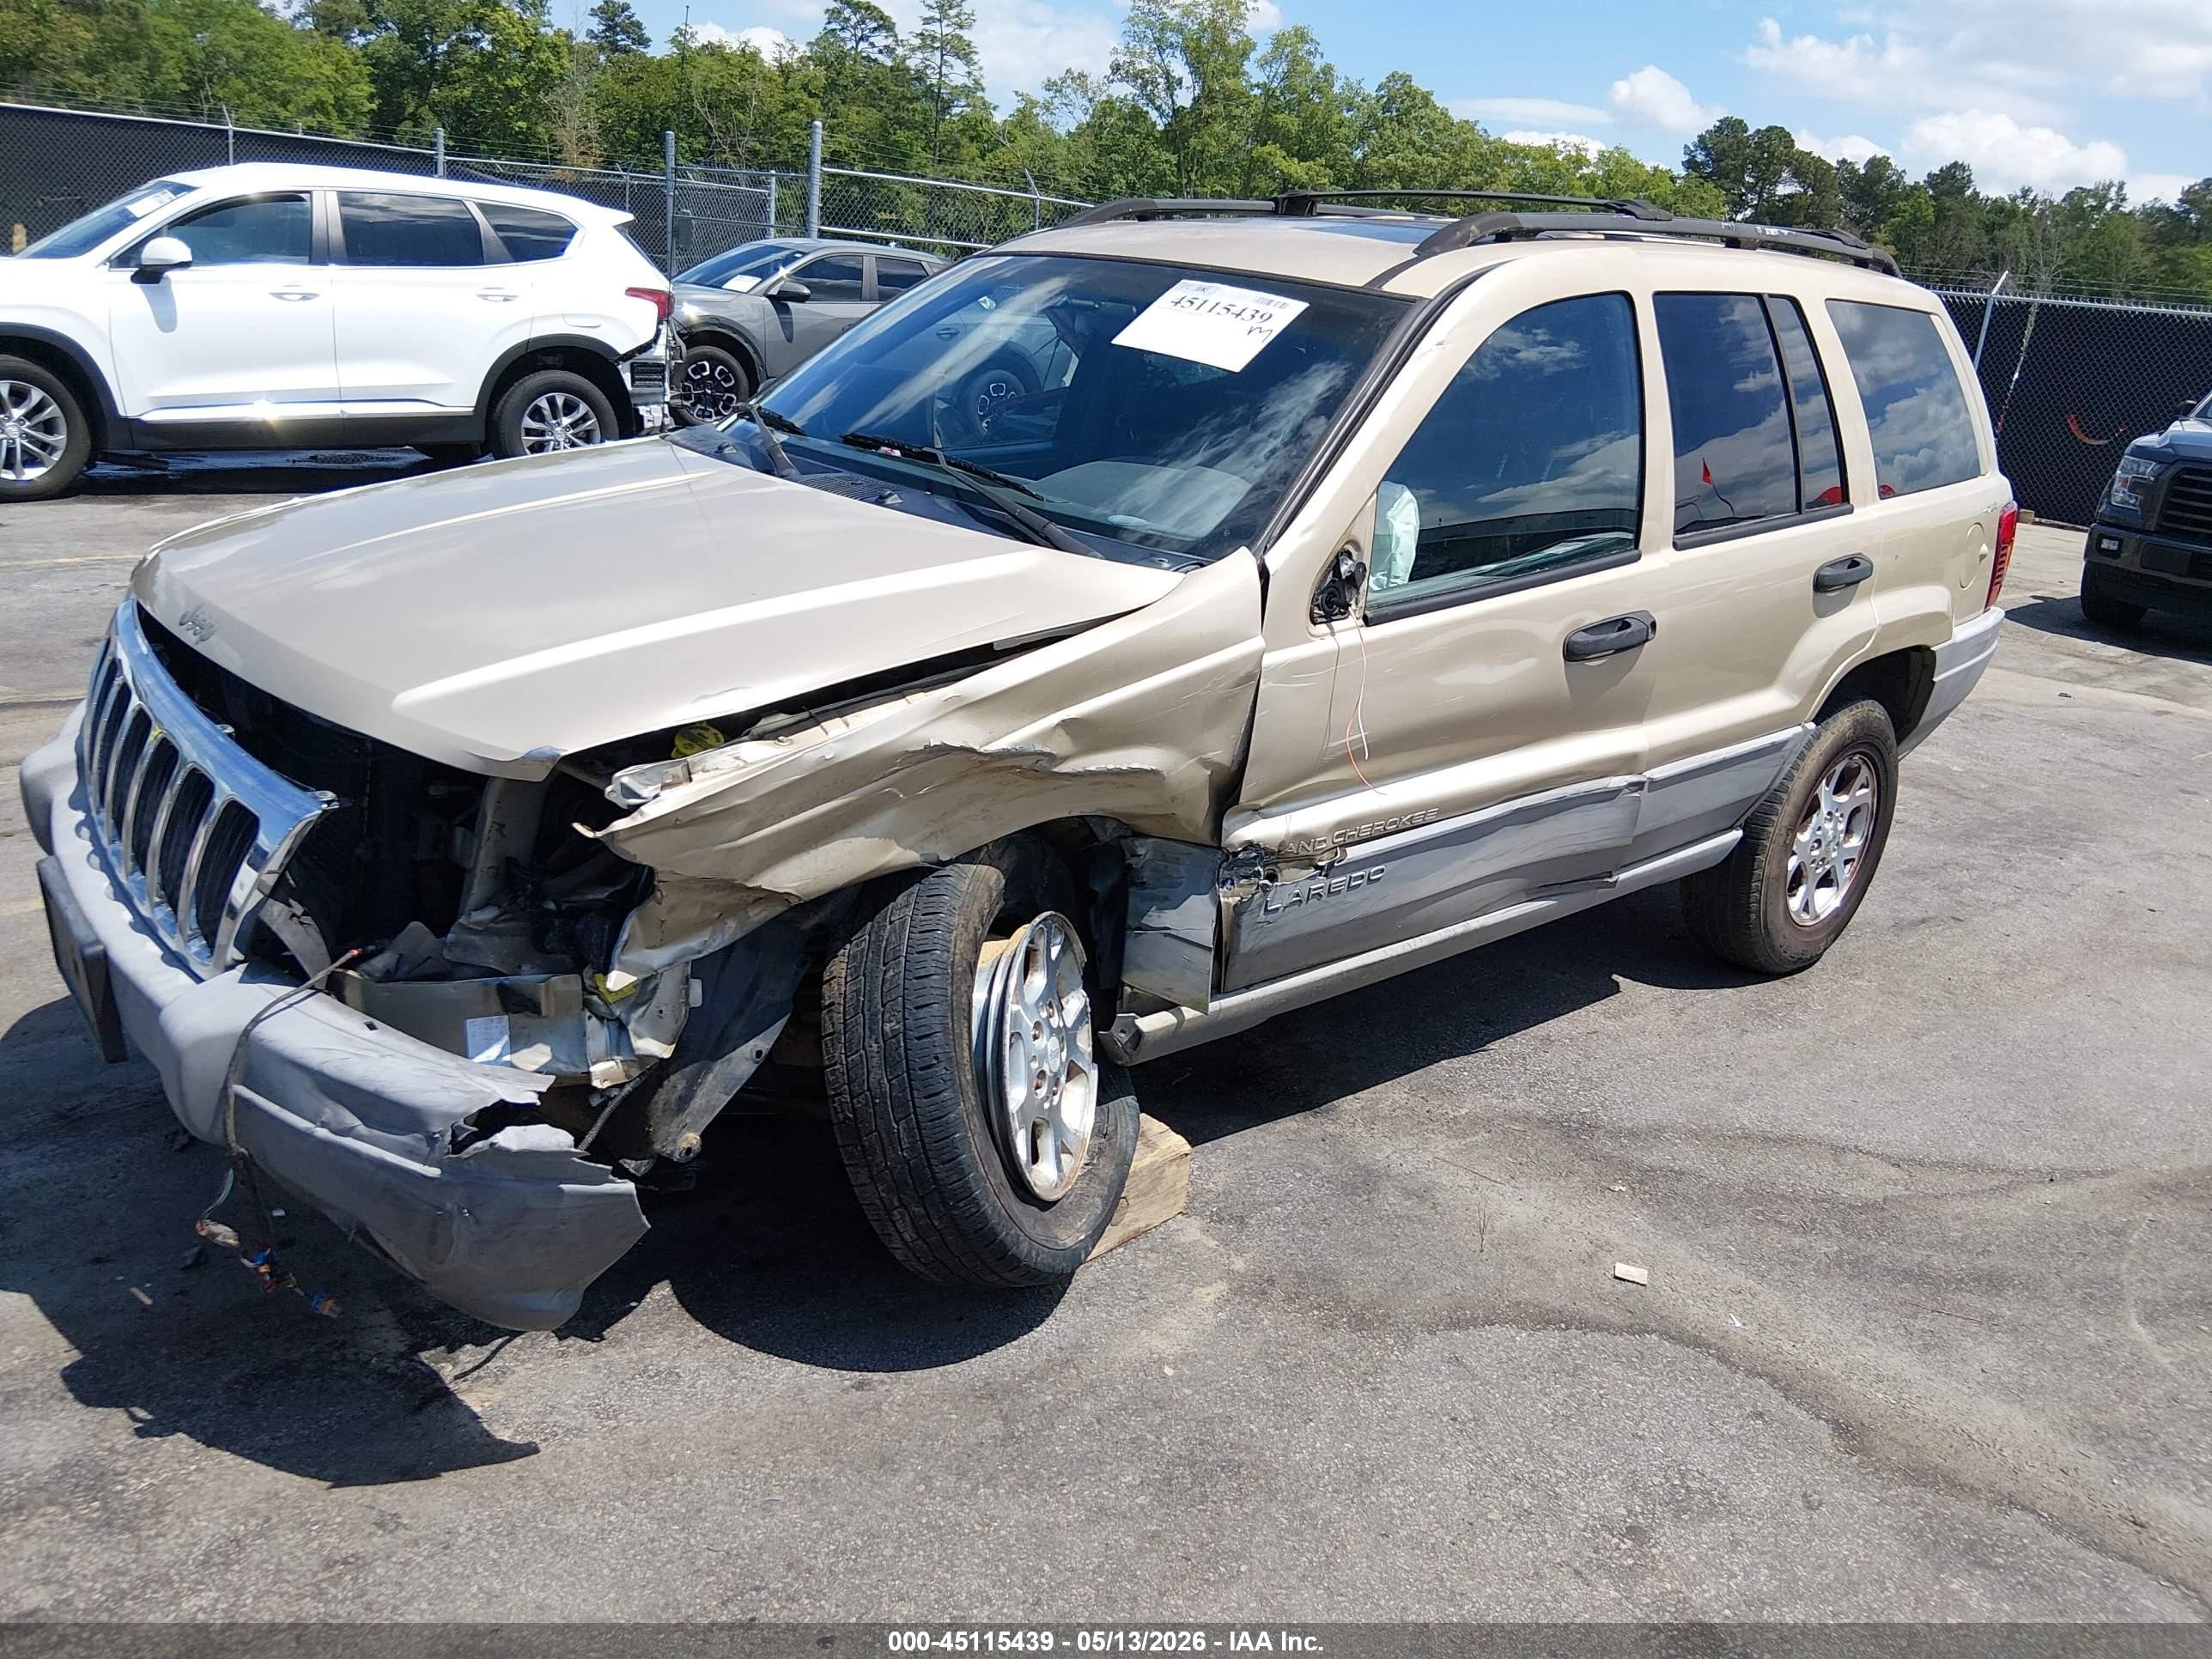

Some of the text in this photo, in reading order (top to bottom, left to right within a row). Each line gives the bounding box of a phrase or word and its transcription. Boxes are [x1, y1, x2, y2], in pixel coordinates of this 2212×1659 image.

[1170, 295, 1273, 323] 45115439
[1332, 807, 1439, 844] CHEROKEE
[1265, 864, 1387, 914] LAREDO
